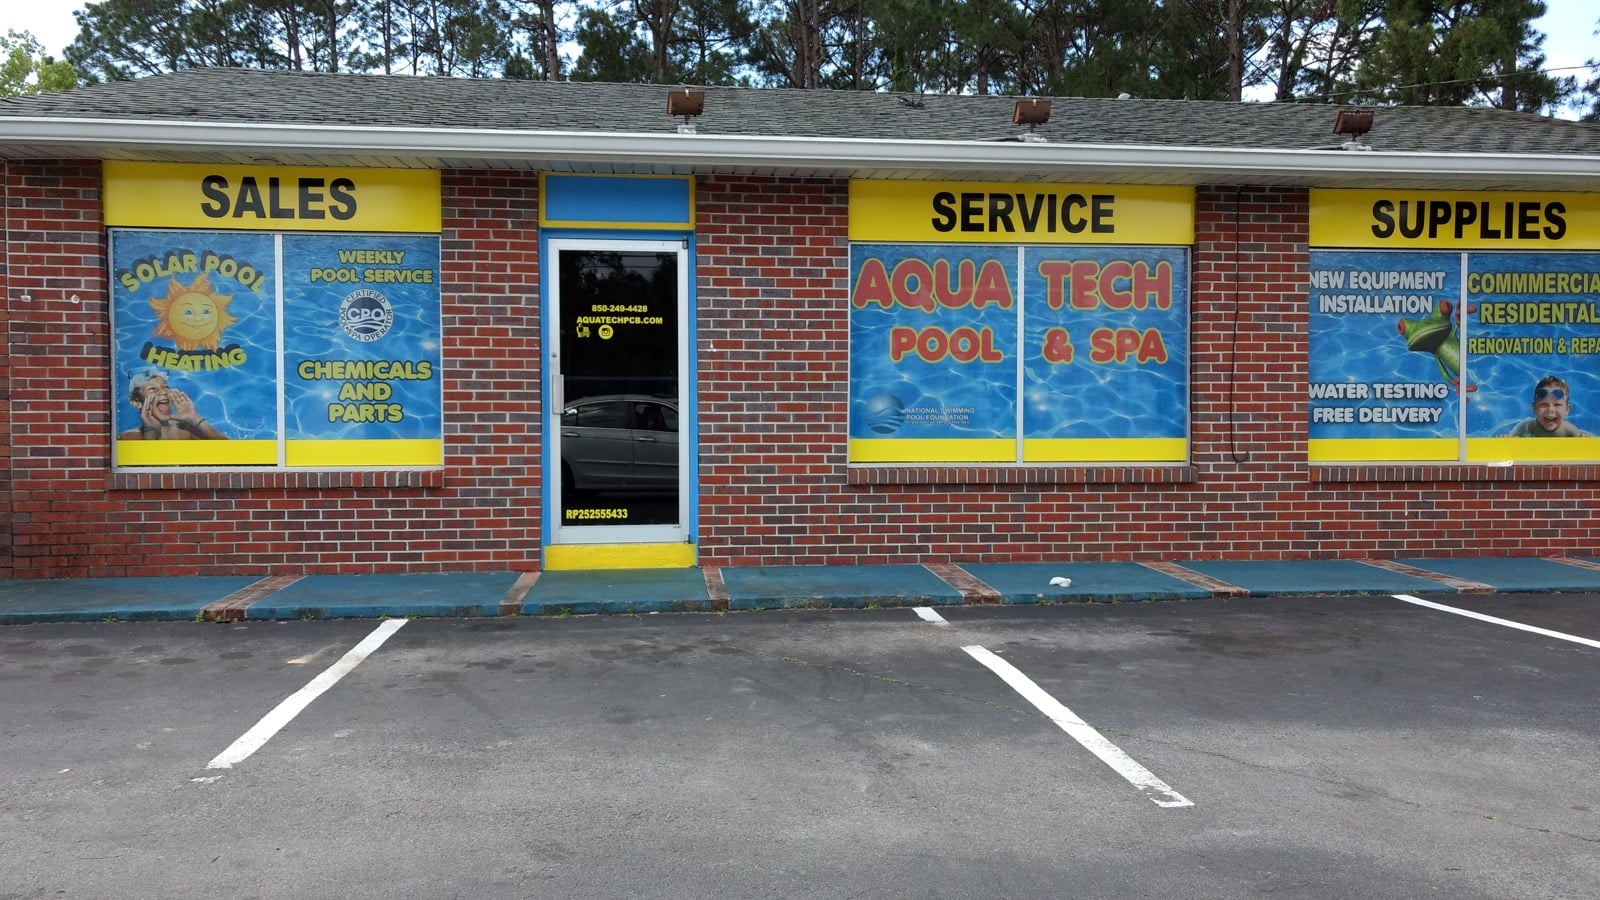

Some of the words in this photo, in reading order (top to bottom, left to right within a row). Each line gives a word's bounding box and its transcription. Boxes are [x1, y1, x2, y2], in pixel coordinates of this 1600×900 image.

[200, 174, 357, 220] SALES
[931, 191, 1115, 234] SERVICE
[1371, 200, 1567, 240] SUPPLIES
[338, 250, 404, 264] WEEKLY
[118, 250, 199, 293] SOLAR
[203, 252, 267, 296] POOL
[310, 268, 359, 284] POOL
[363, 269, 433, 285] SERVICE
[1310, 270, 1345, 290] NEW
[1349, 271, 1446, 291] EQUIPMENT
[852, 257, 1013, 314] AQUA
[1038, 260, 1172, 310] TECH
[346, 289, 386, 304] CERTIFIED
[1319, 294, 1434, 314] INSTALLATION
[347, 307, 385, 321] CPO
[591, 304, 648, 312] 850-249-4428
[1480, 302, 1600, 324] RESIDENTAL
[346, 328, 362, 341] SPA
[363, 308, 393, 342] OPERATOR
[576, 316, 663, 324] AQUATECHPCB.COM
[890, 326, 1004, 364] POOL
[1042, 328, 1074, 365] &
[1089, 328, 1169, 365] SPA
[1468, 337, 1553, 354] RENOVATION
[1557, 338, 1567, 354] &
[141, 345, 248, 372] HEATING
[298, 360, 433, 380] CHEMICALS
[339, 383, 392, 401] AND
[1309, 383, 1369, 399] WATER
[1373, 383, 1449, 399] TESTING
[328, 404, 404, 422] PARTS
[1313, 407, 1354, 423] FREE
[1359, 407, 1443, 423] DELIVERY
[566, 509, 628, 519] RP252555433
